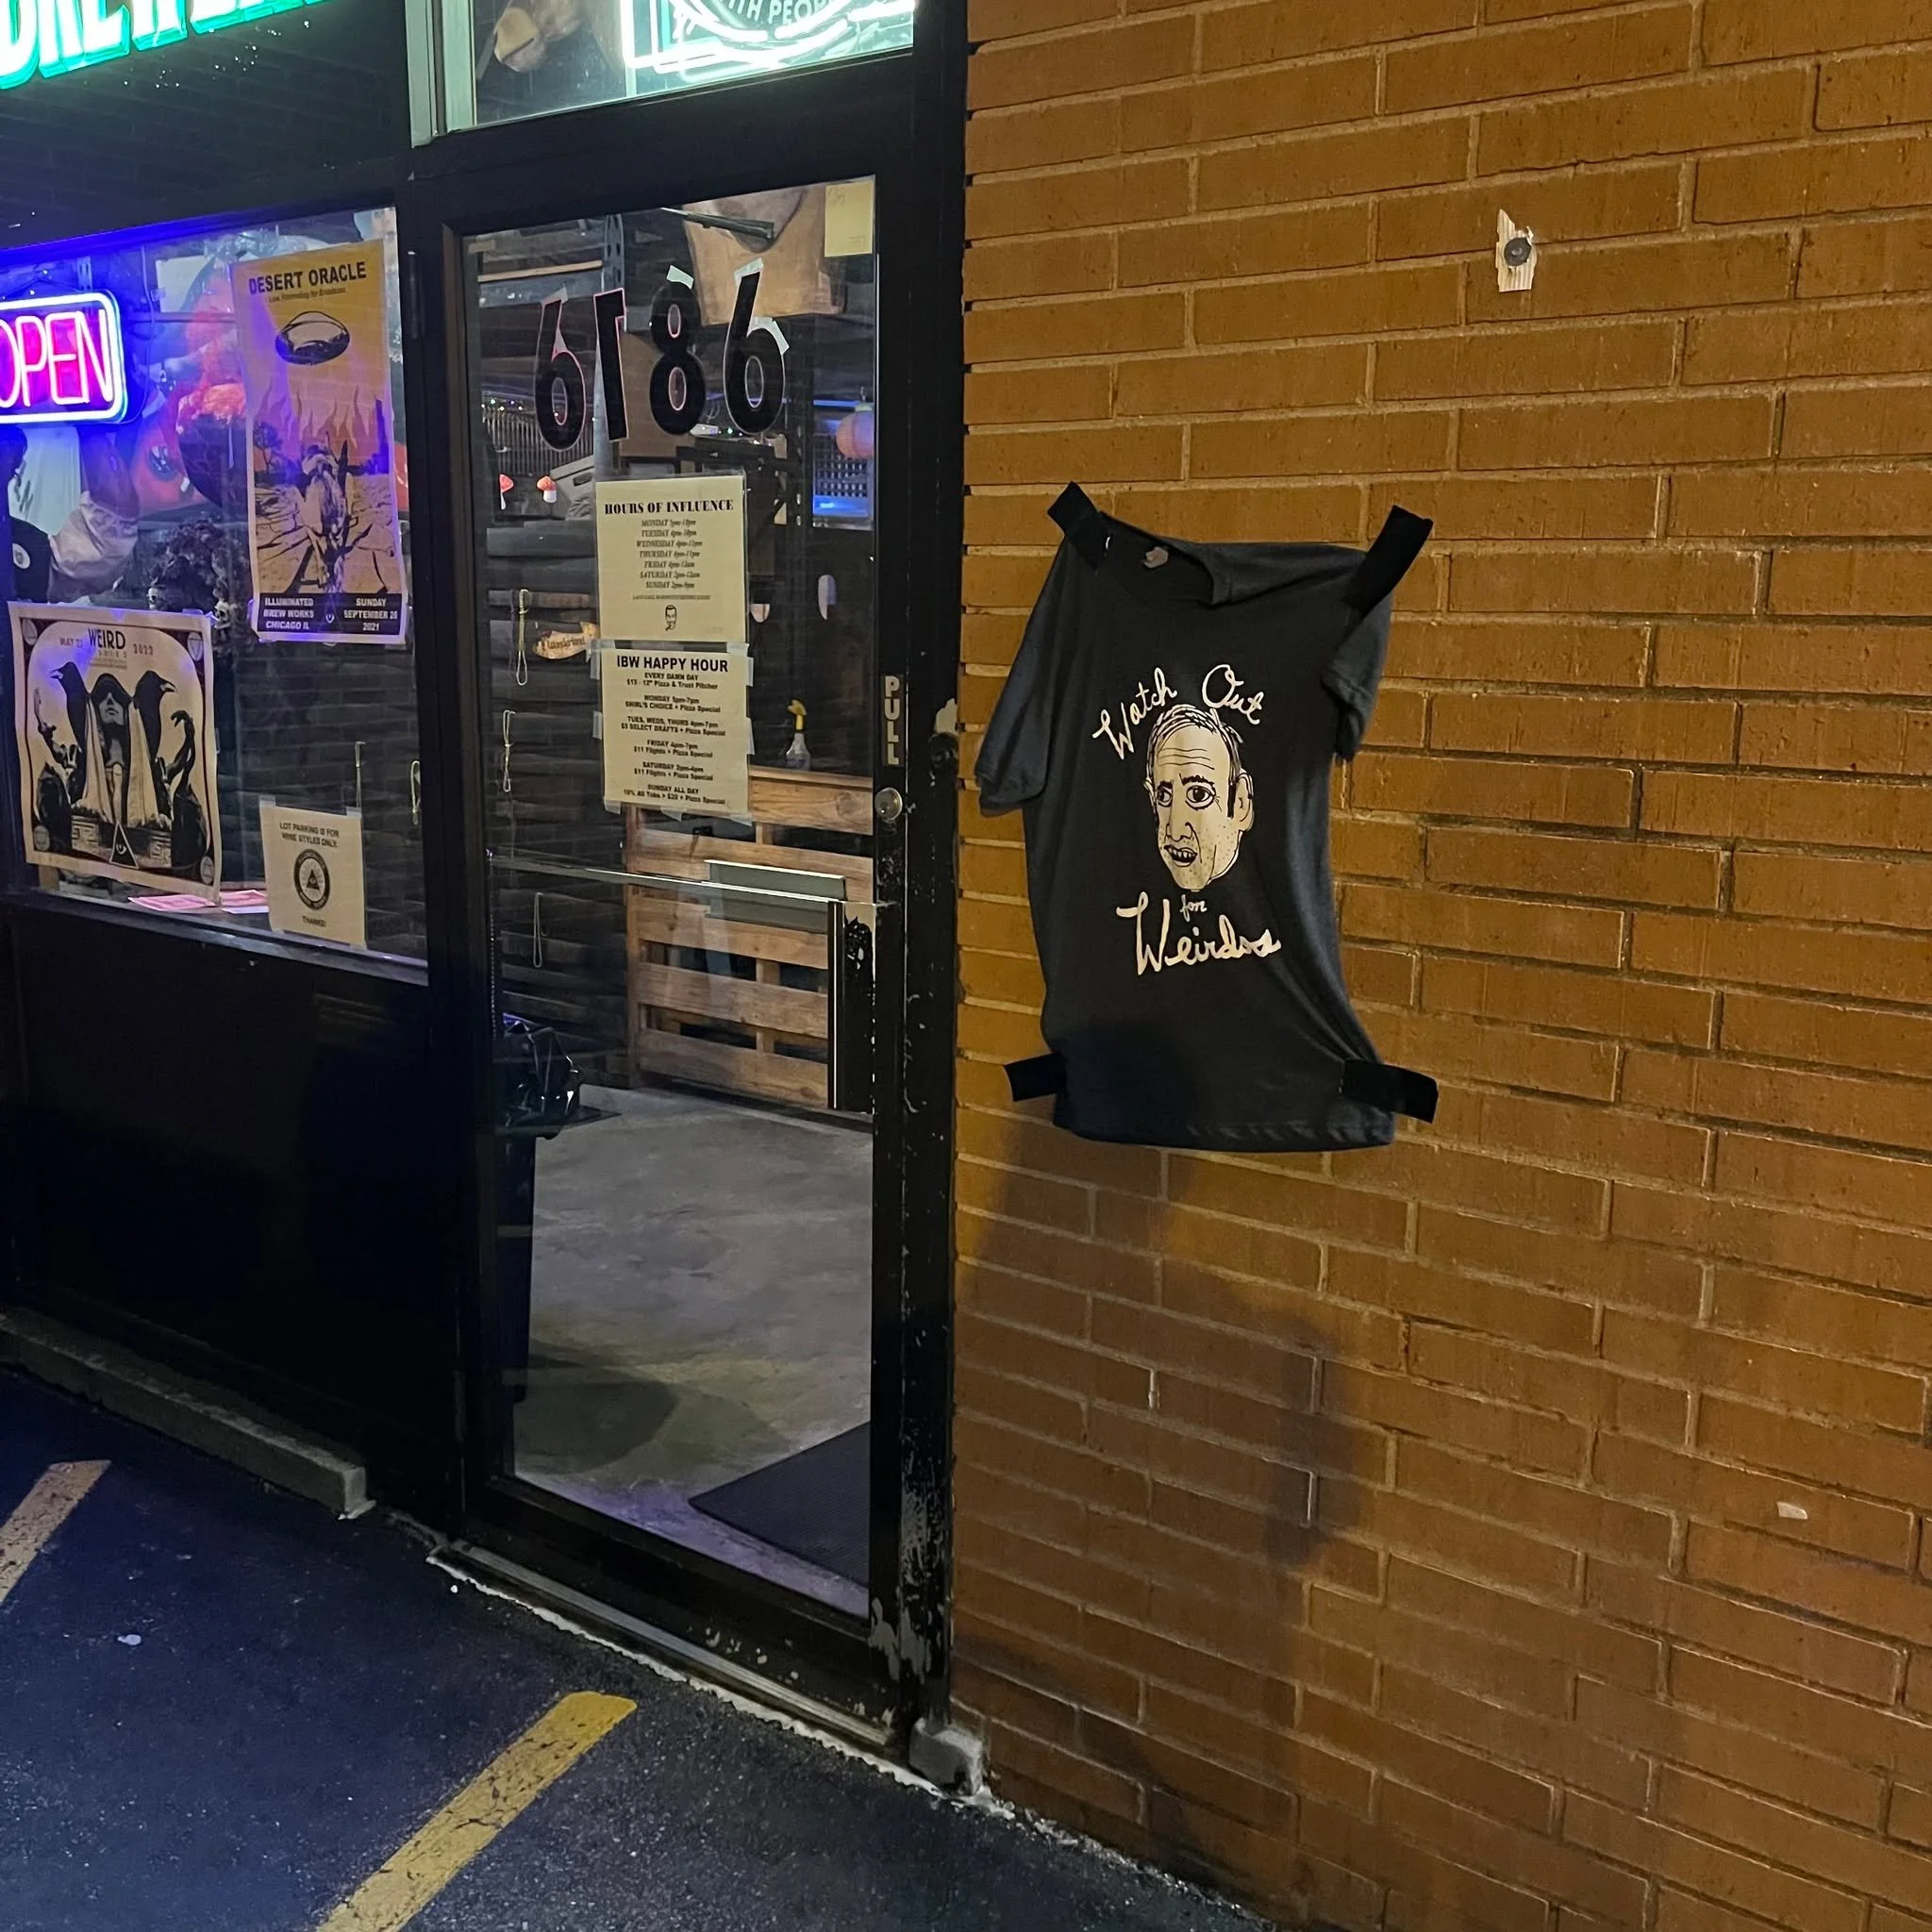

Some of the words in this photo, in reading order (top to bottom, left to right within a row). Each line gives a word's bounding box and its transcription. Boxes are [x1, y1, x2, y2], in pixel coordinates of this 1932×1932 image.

[249, 272, 303, 294] DESERT
[308, 261, 367, 286] ORACLE
[605, 503, 643, 514] HOURS
[648, 502, 663, 512] OF
[667, 499, 733, 512] INFLUENCE
[265, 598, 313, 607] ILLUMINATED
[357, 598, 386, 607] SUNDAY
[263, 609, 286, 618] BREW
[344, 610, 388, 619] SEPTEMBER
[59, 638, 75, 646] MAY
[88, 628, 126, 650] WEIRD
[617, 656, 640, 668] IBW
[644, 658, 687, 670] HAPPY
[691, 659, 728, 672] HOUR
[1092, 667, 1177, 759] Watch
[1202, 664, 1264, 724] Out
[884, 675, 900, 765] PULL
[646, 769, 666, 777] Flights
[292, 824, 318, 835] PARKING
[326, 829, 340, 838] FOR
[299, 835, 320, 845] STYLES
[1179, 894, 1207, 922] for
[1116, 891, 1282, 976] Weirdos
